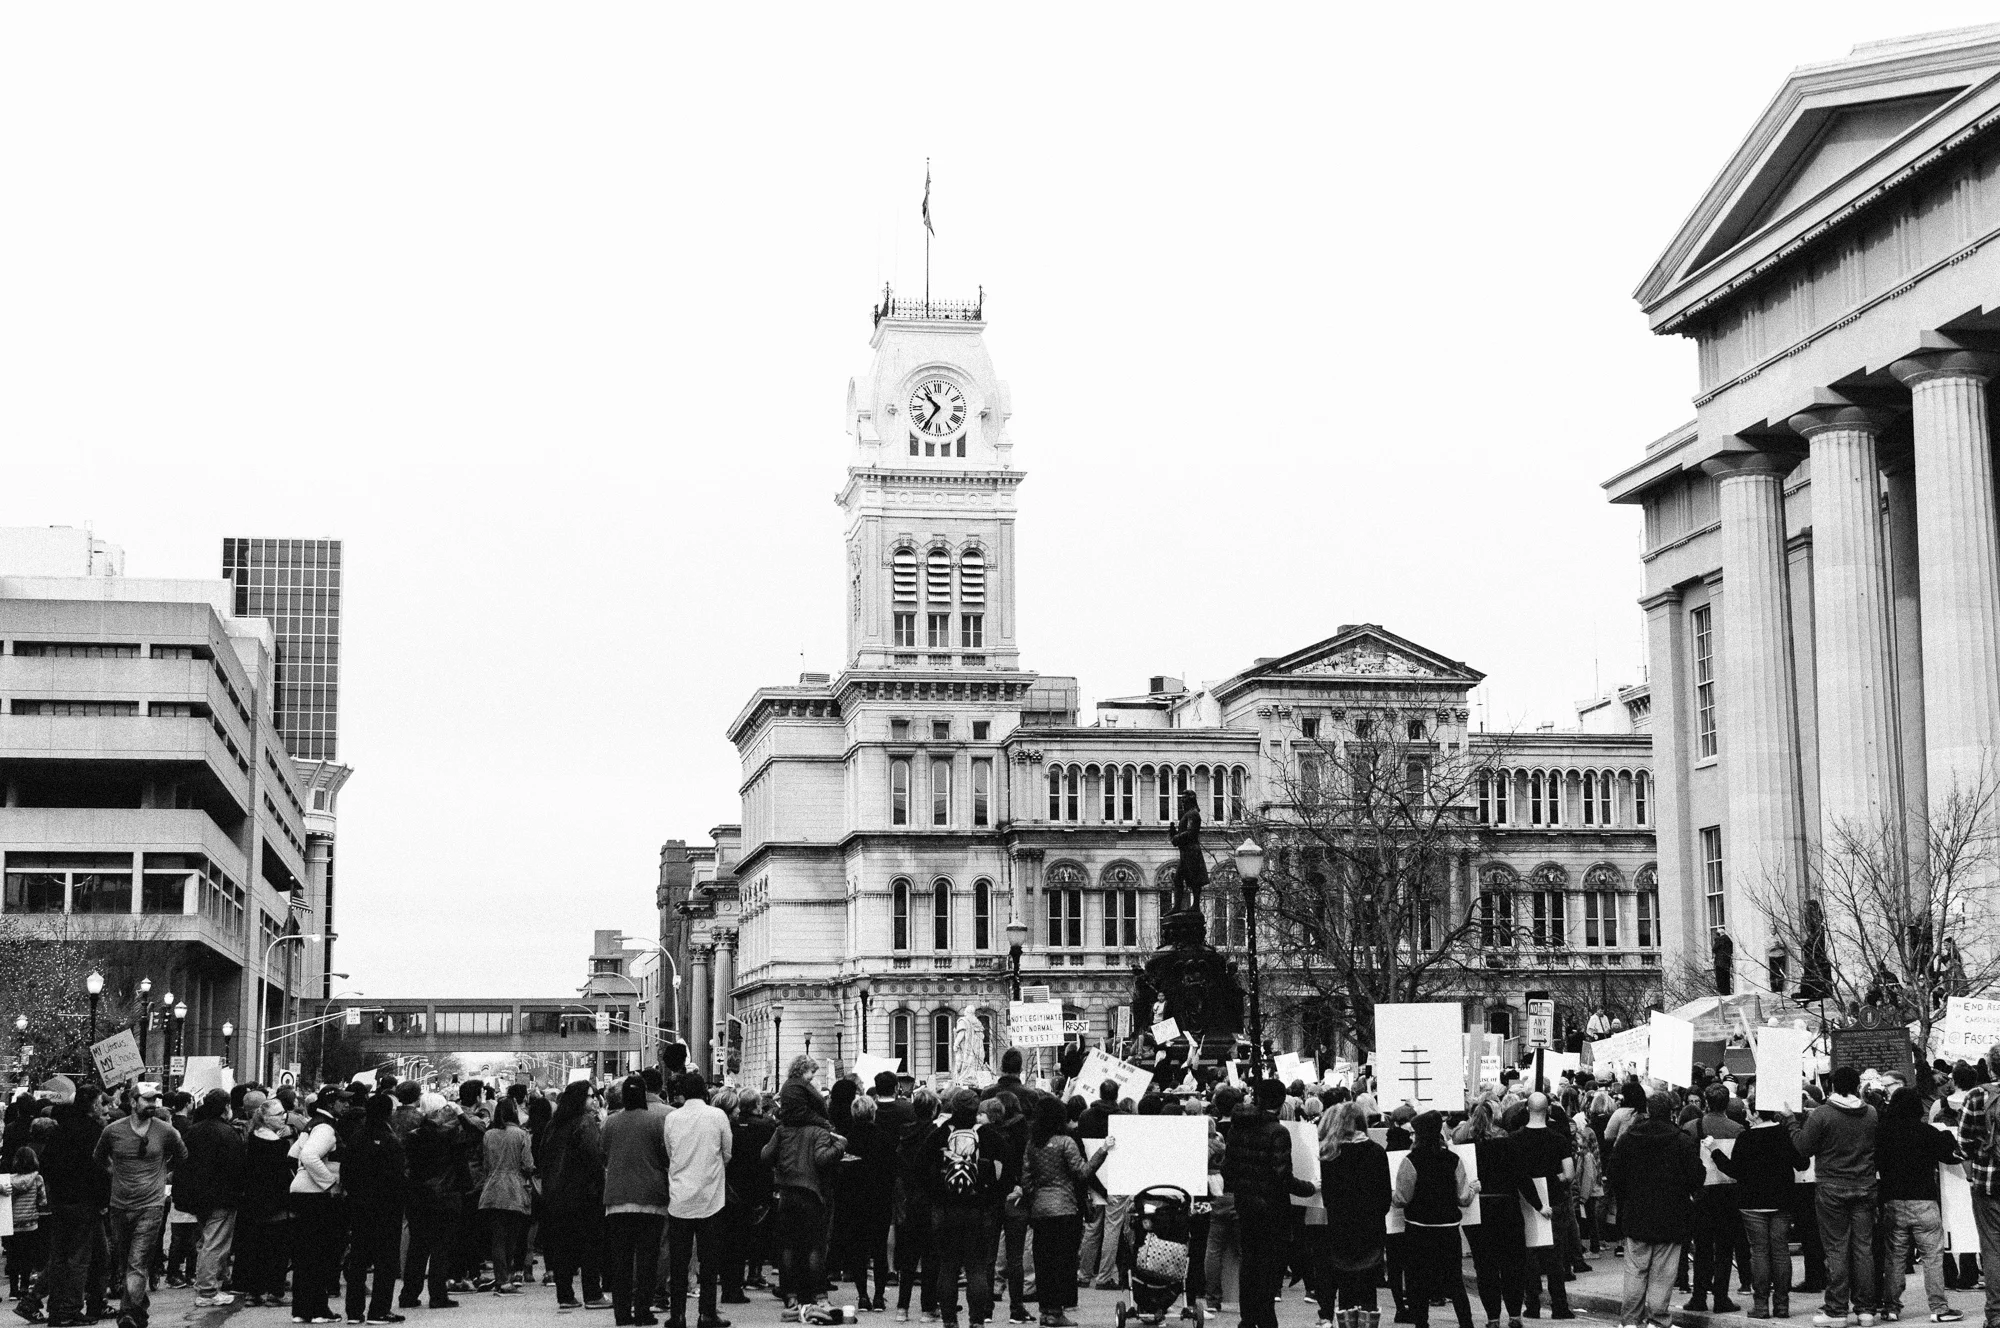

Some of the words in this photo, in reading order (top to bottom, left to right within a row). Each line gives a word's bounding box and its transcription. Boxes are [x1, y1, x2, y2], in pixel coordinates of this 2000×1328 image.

[1308, 690, 1331, 698] CITY
[1340, 690, 1365, 699] HALL
[1530, 1003, 1538, 1014] NO
[1964, 1002, 1983, 1011] END
[1025, 1013, 1062, 1022] LEGITIMATE
[1533, 1018, 1547, 1026] ANY
[1012, 1025, 1023, 1033] NOT
[1065, 1021, 1088, 1031] RESIST
[1533, 1027, 1547, 1036] TIME
[92, 1047, 102, 1058] MY
[100, 1055, 114, 1072] MY
